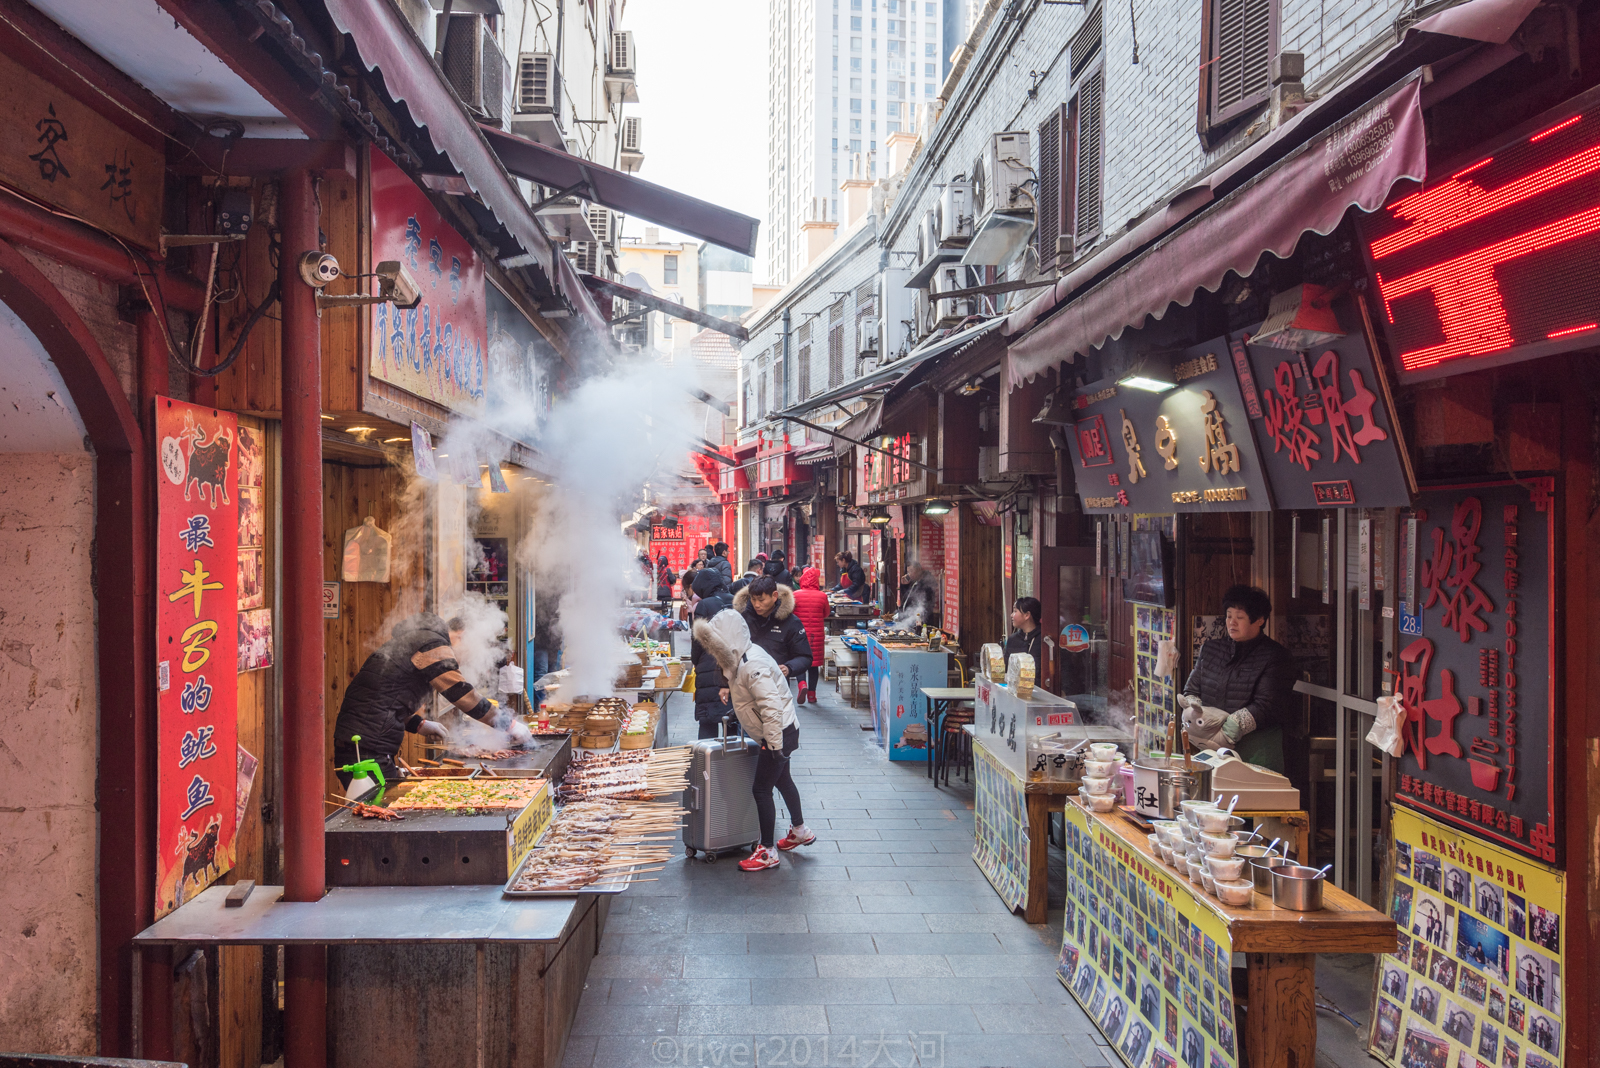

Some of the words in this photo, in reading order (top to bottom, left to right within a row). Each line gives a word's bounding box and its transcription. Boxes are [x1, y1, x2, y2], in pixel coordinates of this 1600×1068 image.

[405, 214, 463, 305] 老字号
[1119, 389, 1241, 485] 臭豆腐
[168, 514, 224, 821] 最牛B的鱿鱼
[1068, 627, 1083, 642] 拉
[1401, 773, 1523, 838] 绿禾餐饮管理有限公司
